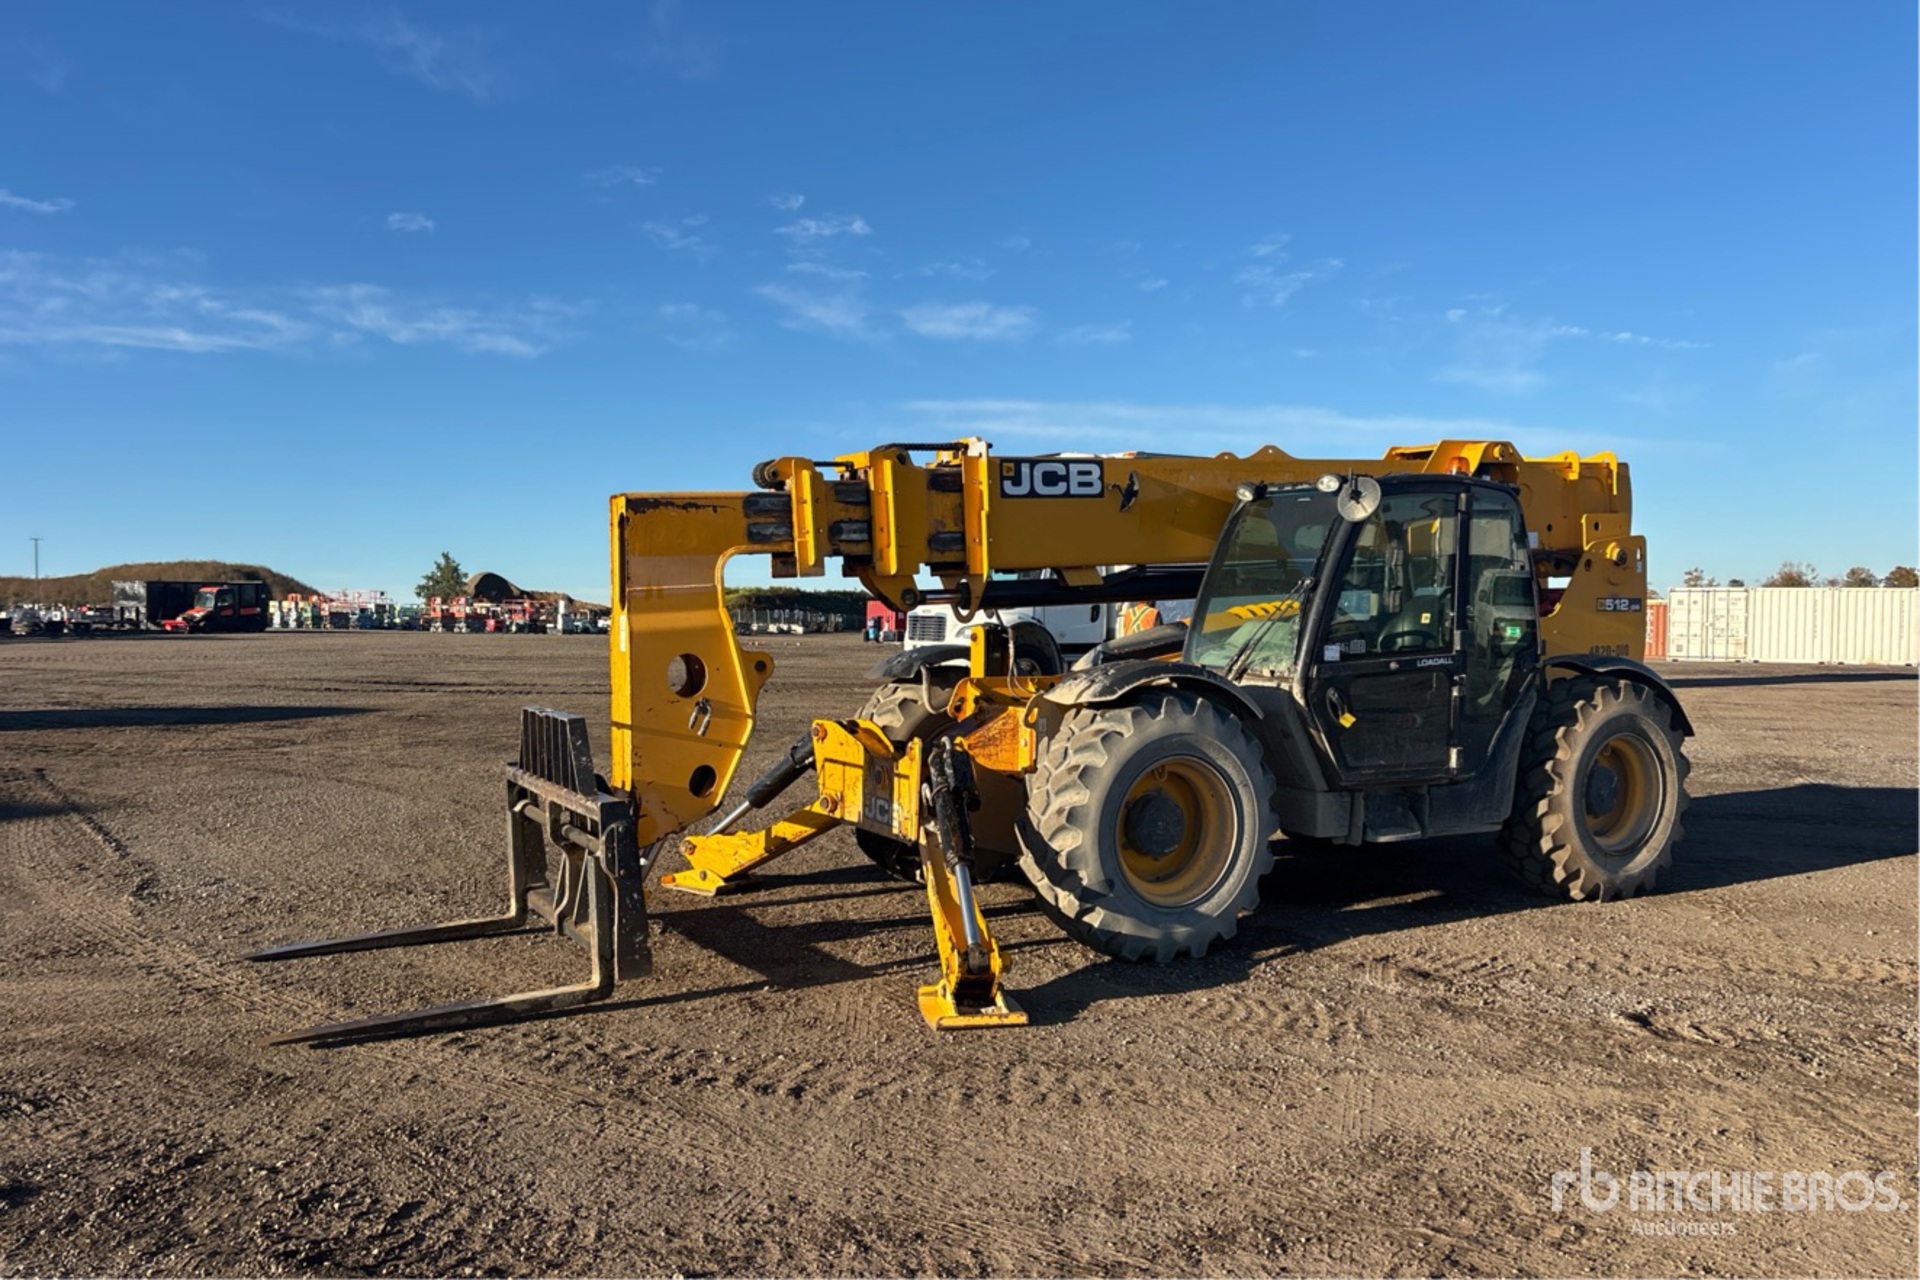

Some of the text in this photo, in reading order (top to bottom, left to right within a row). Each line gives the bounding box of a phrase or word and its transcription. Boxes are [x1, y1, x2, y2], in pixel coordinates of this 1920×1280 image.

[1002, 462, 1102, 495] JCB
[1605, 598, 1629, 610] 512
[1417, 657, 1453, 667] LOADALL
